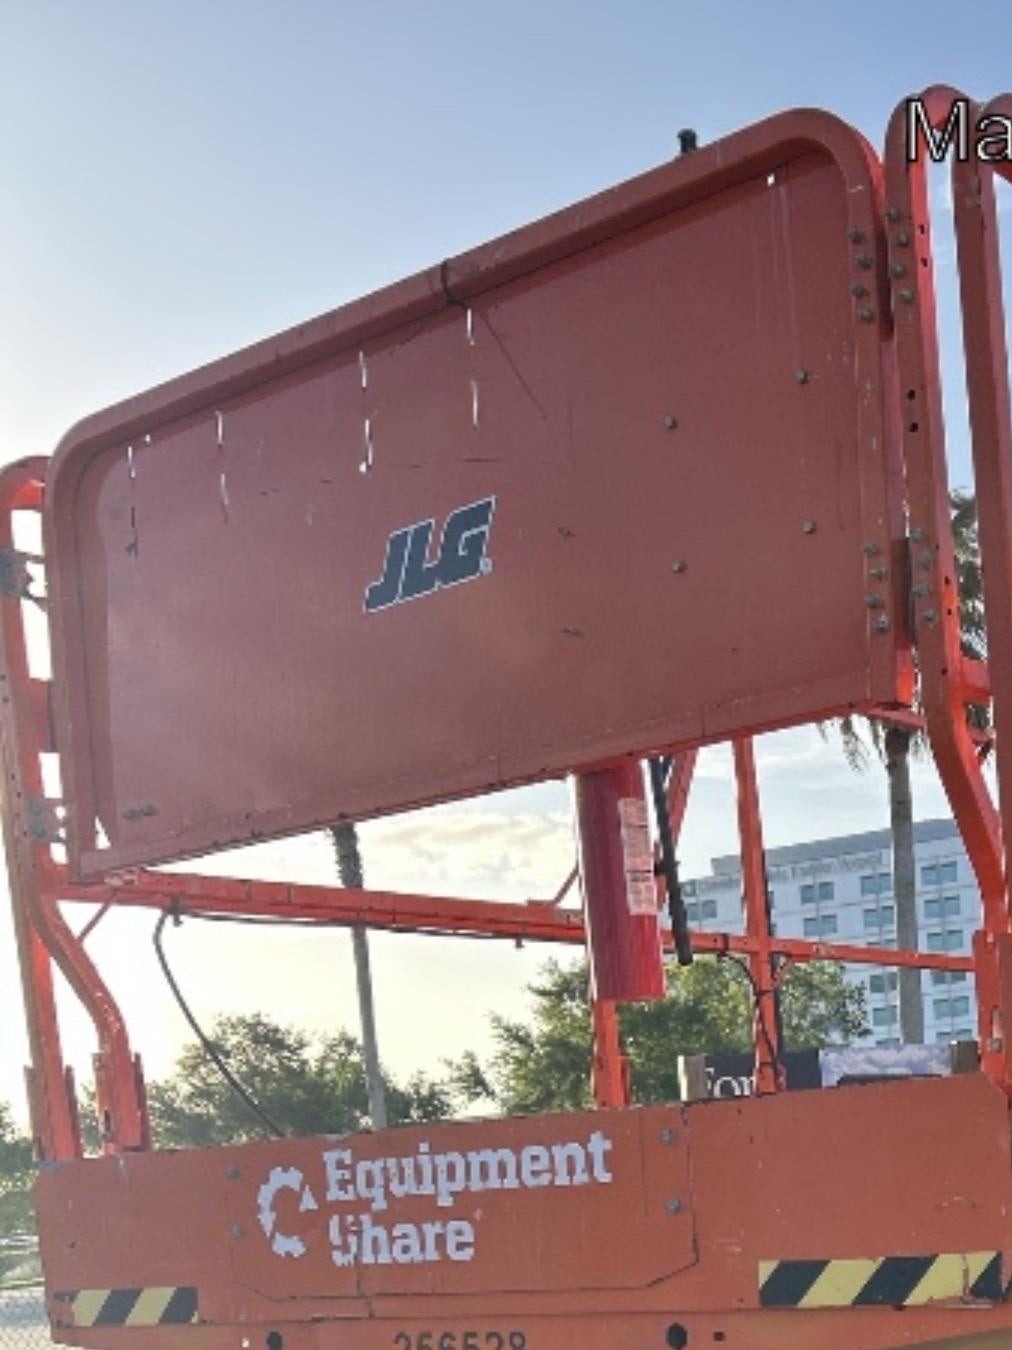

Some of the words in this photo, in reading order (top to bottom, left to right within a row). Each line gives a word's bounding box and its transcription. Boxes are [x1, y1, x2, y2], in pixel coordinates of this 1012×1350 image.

[362, 494, 493, 614] JLG
[322, 1131, 613, 1210] Equipment
[328, 1213, 476, 1267] Share
